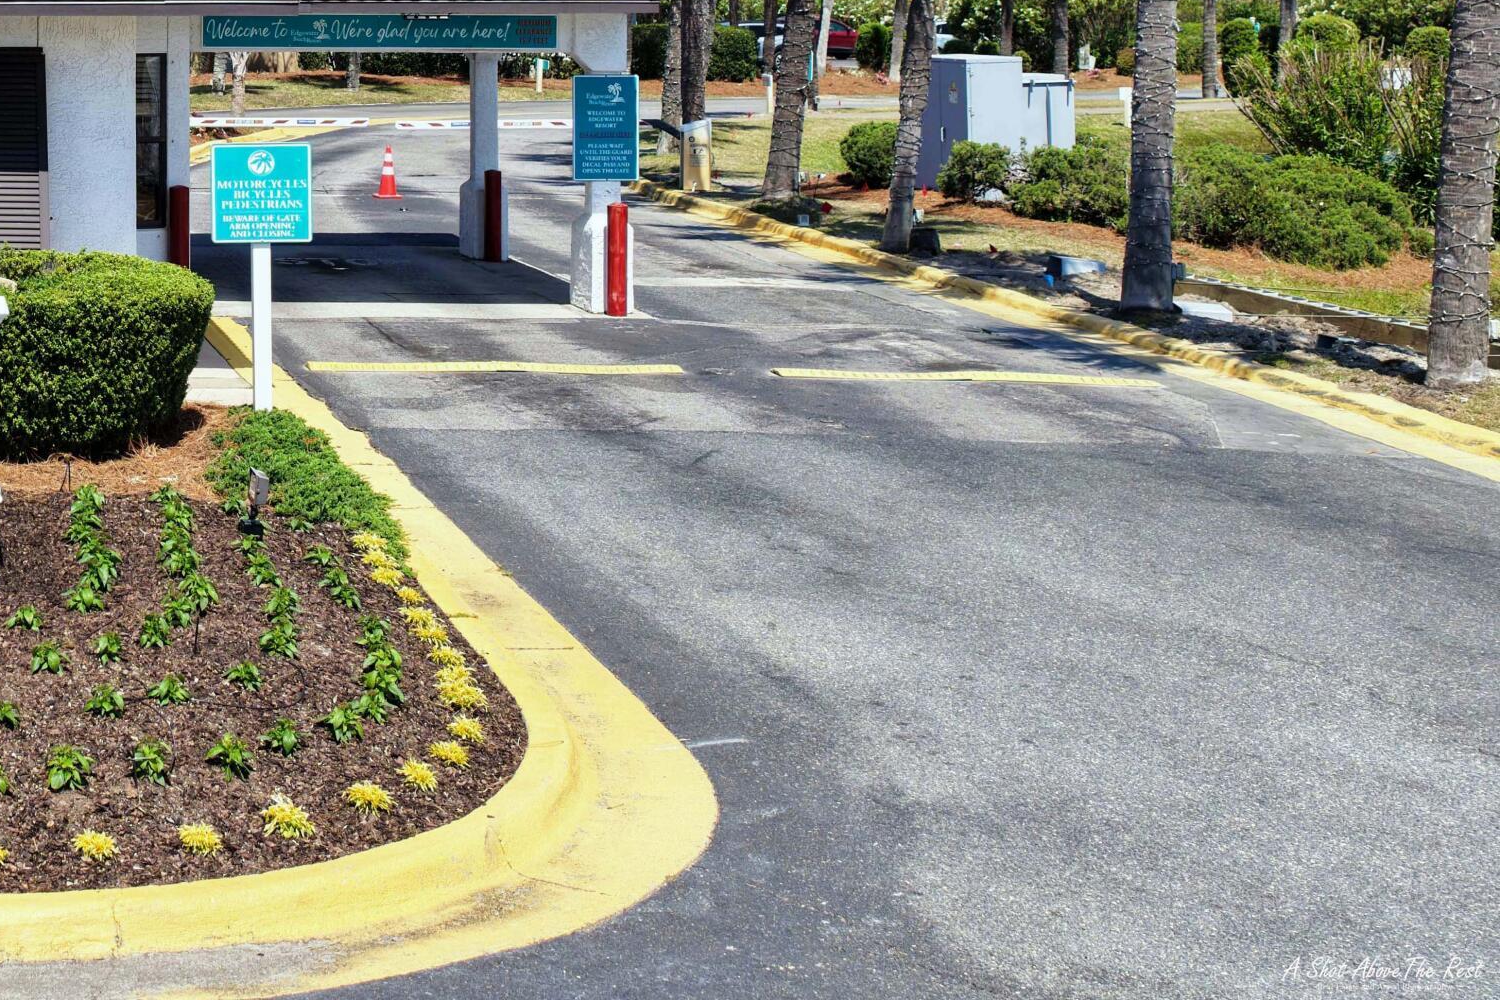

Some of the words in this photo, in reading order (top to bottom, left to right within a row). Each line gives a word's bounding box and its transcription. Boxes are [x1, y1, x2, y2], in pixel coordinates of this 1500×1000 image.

[206, 18, 271, 39] Welcome
[271, 19, 288, 38] to
[377, 20, 413, 43] glad
[414, 26, 438, 43] you
[442, 26, 468, 38] are
[471, 20, 511, 41] here!
[217, 179, 307, 189] MOTORCYCLES
[233, 189, 291, 199] BICYCLES
[221, 200, 303, 209] PEDESTRIANS
[222, 214, 260, 222] BEWARE
[261, 214, 275, 222] OF
[276, 214, 301, 222] GATE
[229, 222, 250, 230] ARM
[251, 222, 295, 230] OPENING
[230, 230, 251, 238] AND
[252, 230, 295, 238] CLOSING
